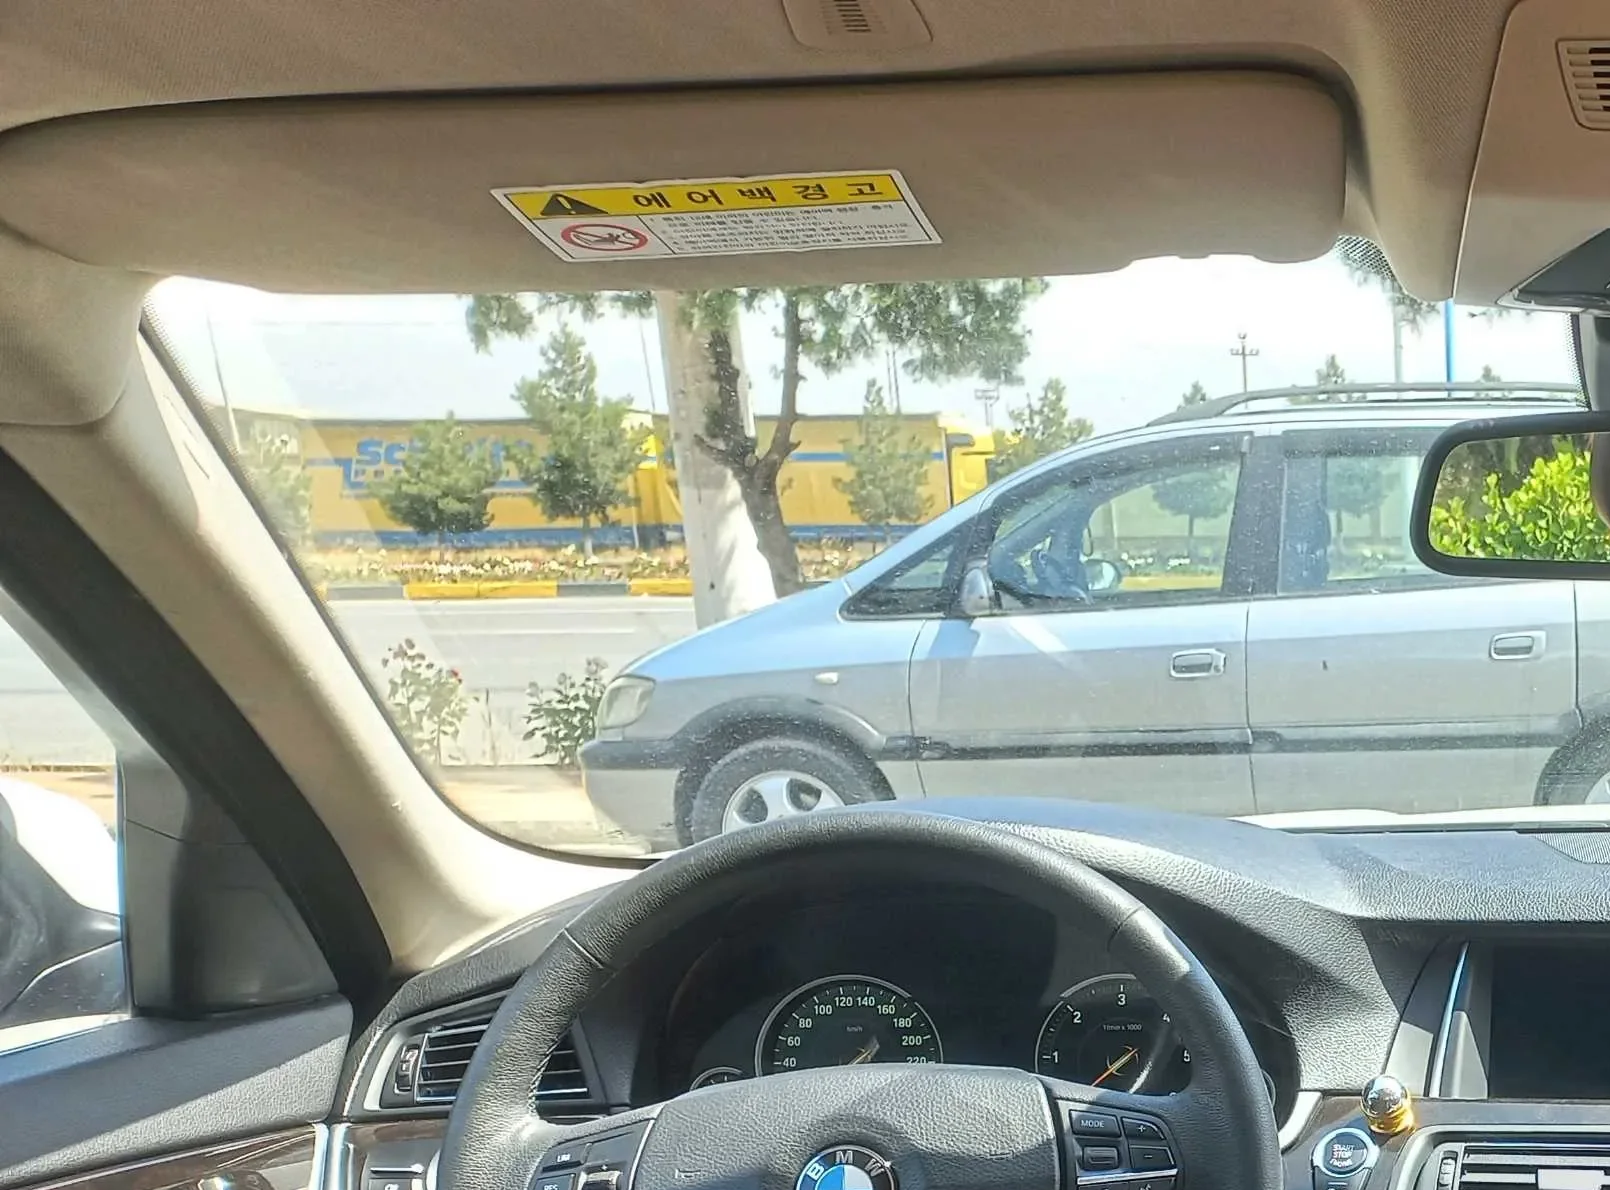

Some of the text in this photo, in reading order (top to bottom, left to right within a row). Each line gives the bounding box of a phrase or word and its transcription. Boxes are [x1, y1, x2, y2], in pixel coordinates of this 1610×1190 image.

[834, 996, 853, 1007] 120
[856, 996, 876, 1007] 140
[1117, 993, 1126, 1006] 3
[813, 1004, 833, 1015] 100
[876, 1004, 896, 1015] 160
[1072, 1011, 1082, 1023] 2
[798, 1017, 812, 1029] 80
[893, 1017, 912, 1029] 180
[787, 1036, 801, 1047] 60
[902, 1035, 922, 1047] 200
[1183, 1050, 1191, 1062] 5
[783, 1057, 797, 1067] 40
[1080, 1118, 1105, 1129] MODE
[806, 1150, 885, 1181] BMW
